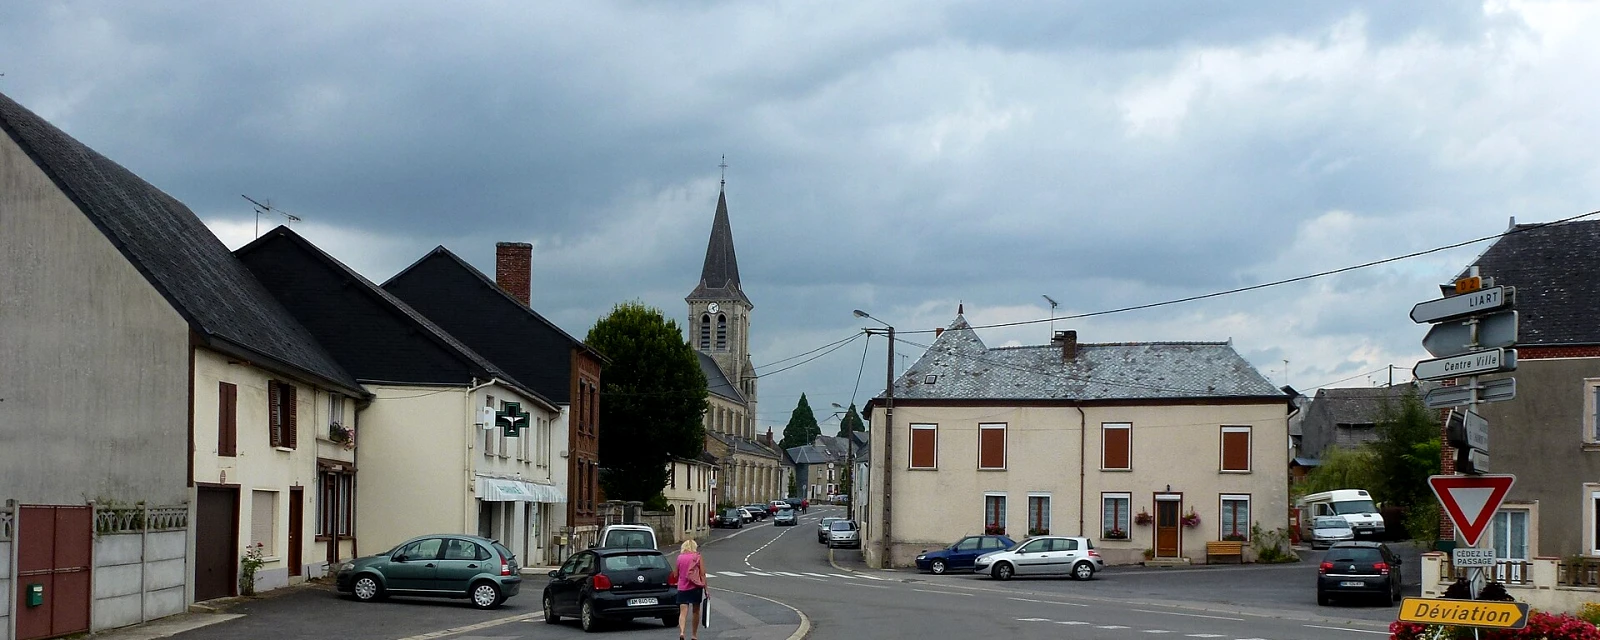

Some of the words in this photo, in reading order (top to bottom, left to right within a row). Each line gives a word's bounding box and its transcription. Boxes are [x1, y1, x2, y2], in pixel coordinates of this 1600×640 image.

[1461, 282, 1466, 290] D
[1470, 280, 1475, 289] 2
[1469, 292, 1498, 307] LIART
[1444, 360, 1471, 371] Centre
[1476, 355, 1497, 366] Ville
[1456, 549, 1481, 557] CÉDEZ
[1414, 602, 1511, 622] Déviation
